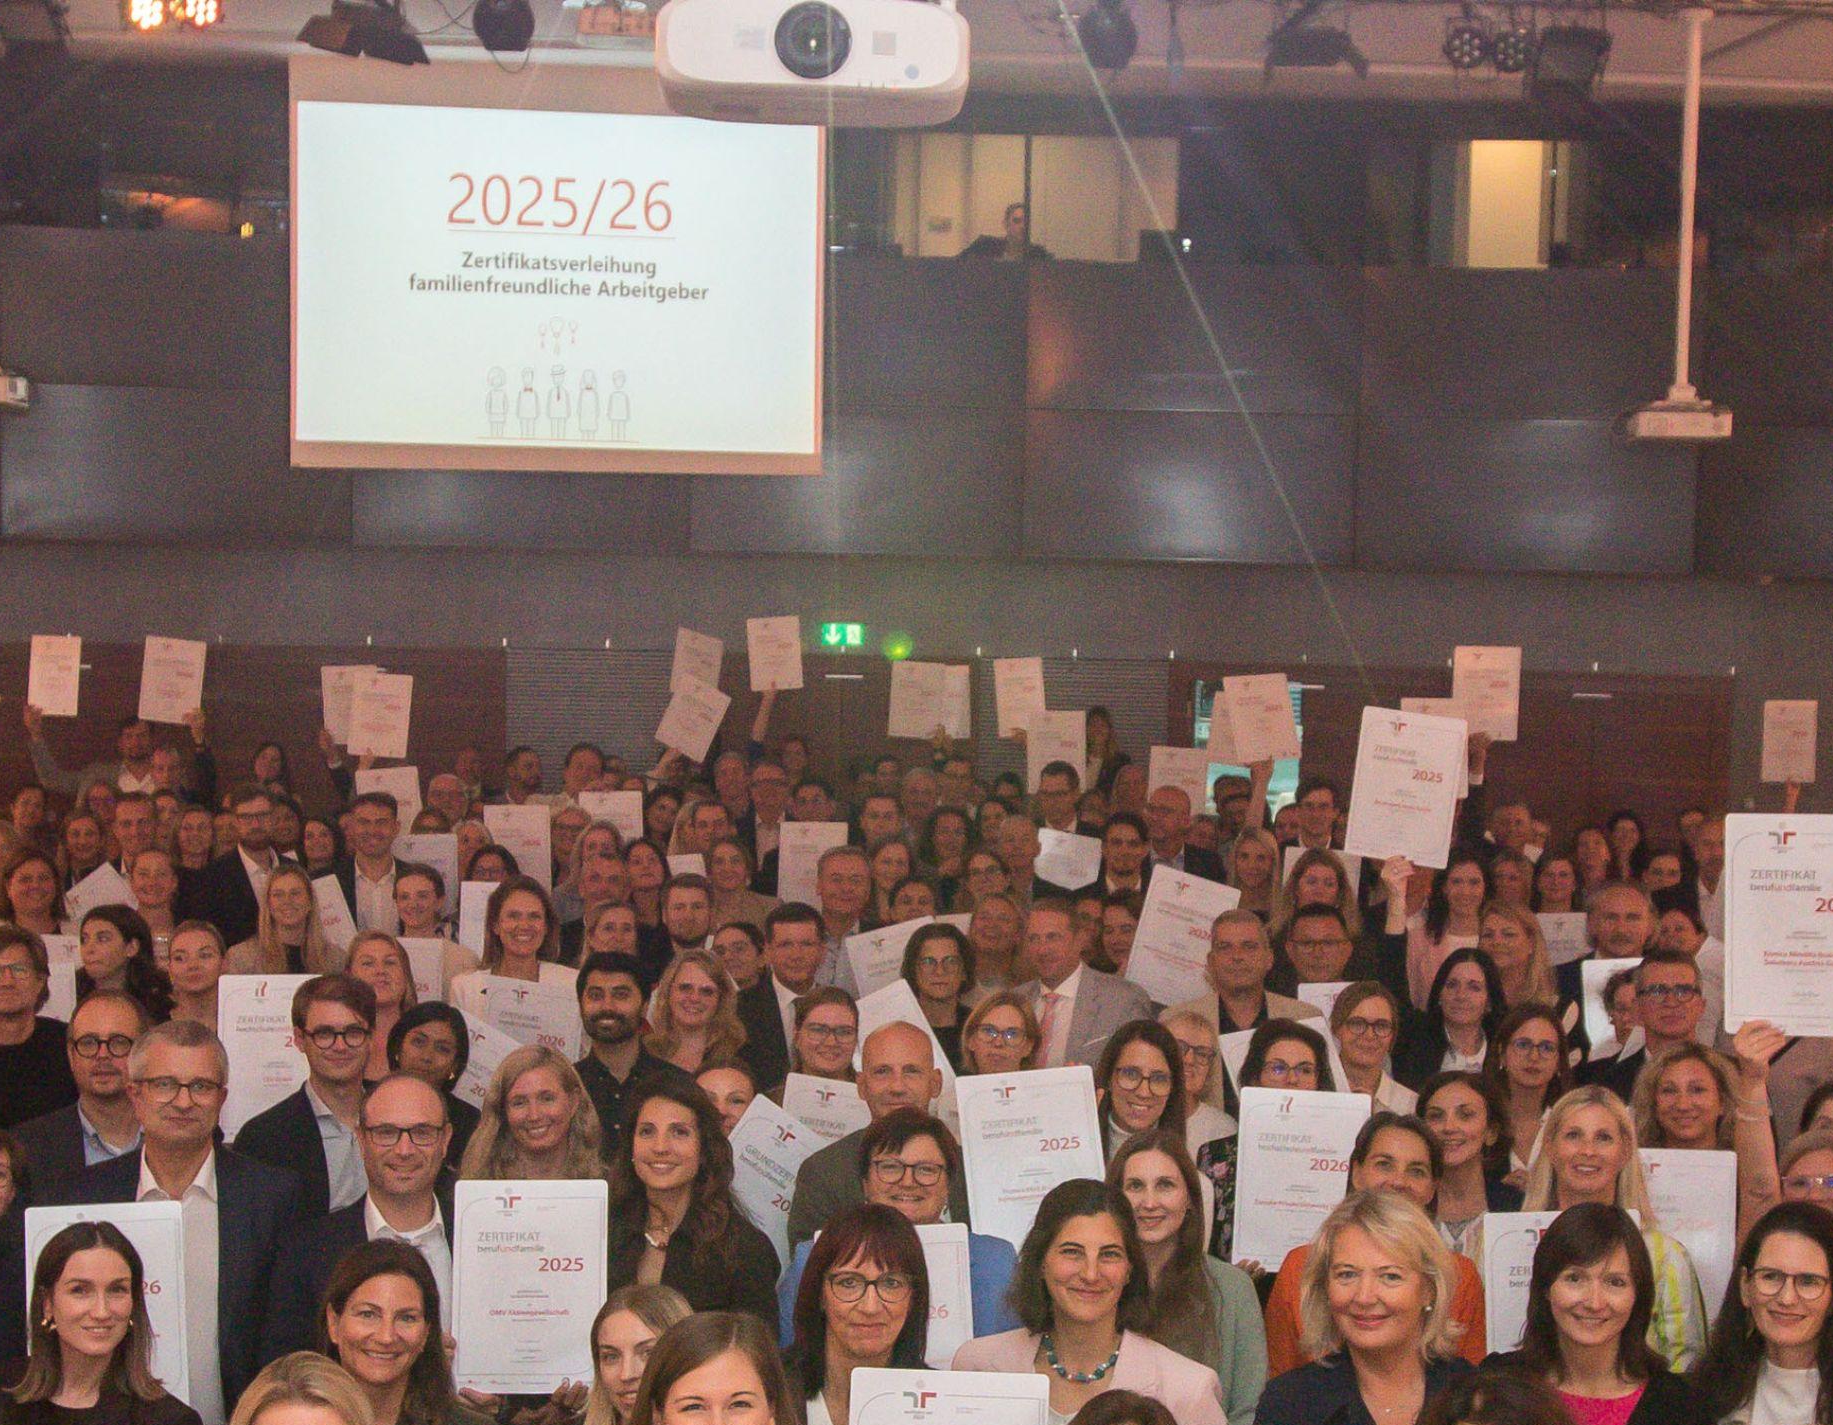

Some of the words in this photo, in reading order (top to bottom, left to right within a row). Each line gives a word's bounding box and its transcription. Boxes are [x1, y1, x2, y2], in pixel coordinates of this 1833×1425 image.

[446, 172, 673, 236] 2025/26
[461, 252, 657, 276] Zertifikatsverleihung
[409, 274, 592, 297] familienfreundliche
[597, 281, 709, 302] Arbeitgeber
[1412, 769, 1443, 783] 2025
[1750, 869, 1817, 880] ZERTIFIKAT
[536, 1033, 565, 1047] 2026
[470, 1082, 486, 1097] 20
[1040, 1137, 1081, 1153] 2025
[745, 1144, 796, 1182] GRUNDZERT
[1310, 1158, 1349, 1173] 2026
[771, 1193, 791, 1212] 20
[477, 1231, 541, 1242] ZERTIFIKAT
[538, 1257, 584, 1272] 2025
[143, 1280, 162, 1295] 26
